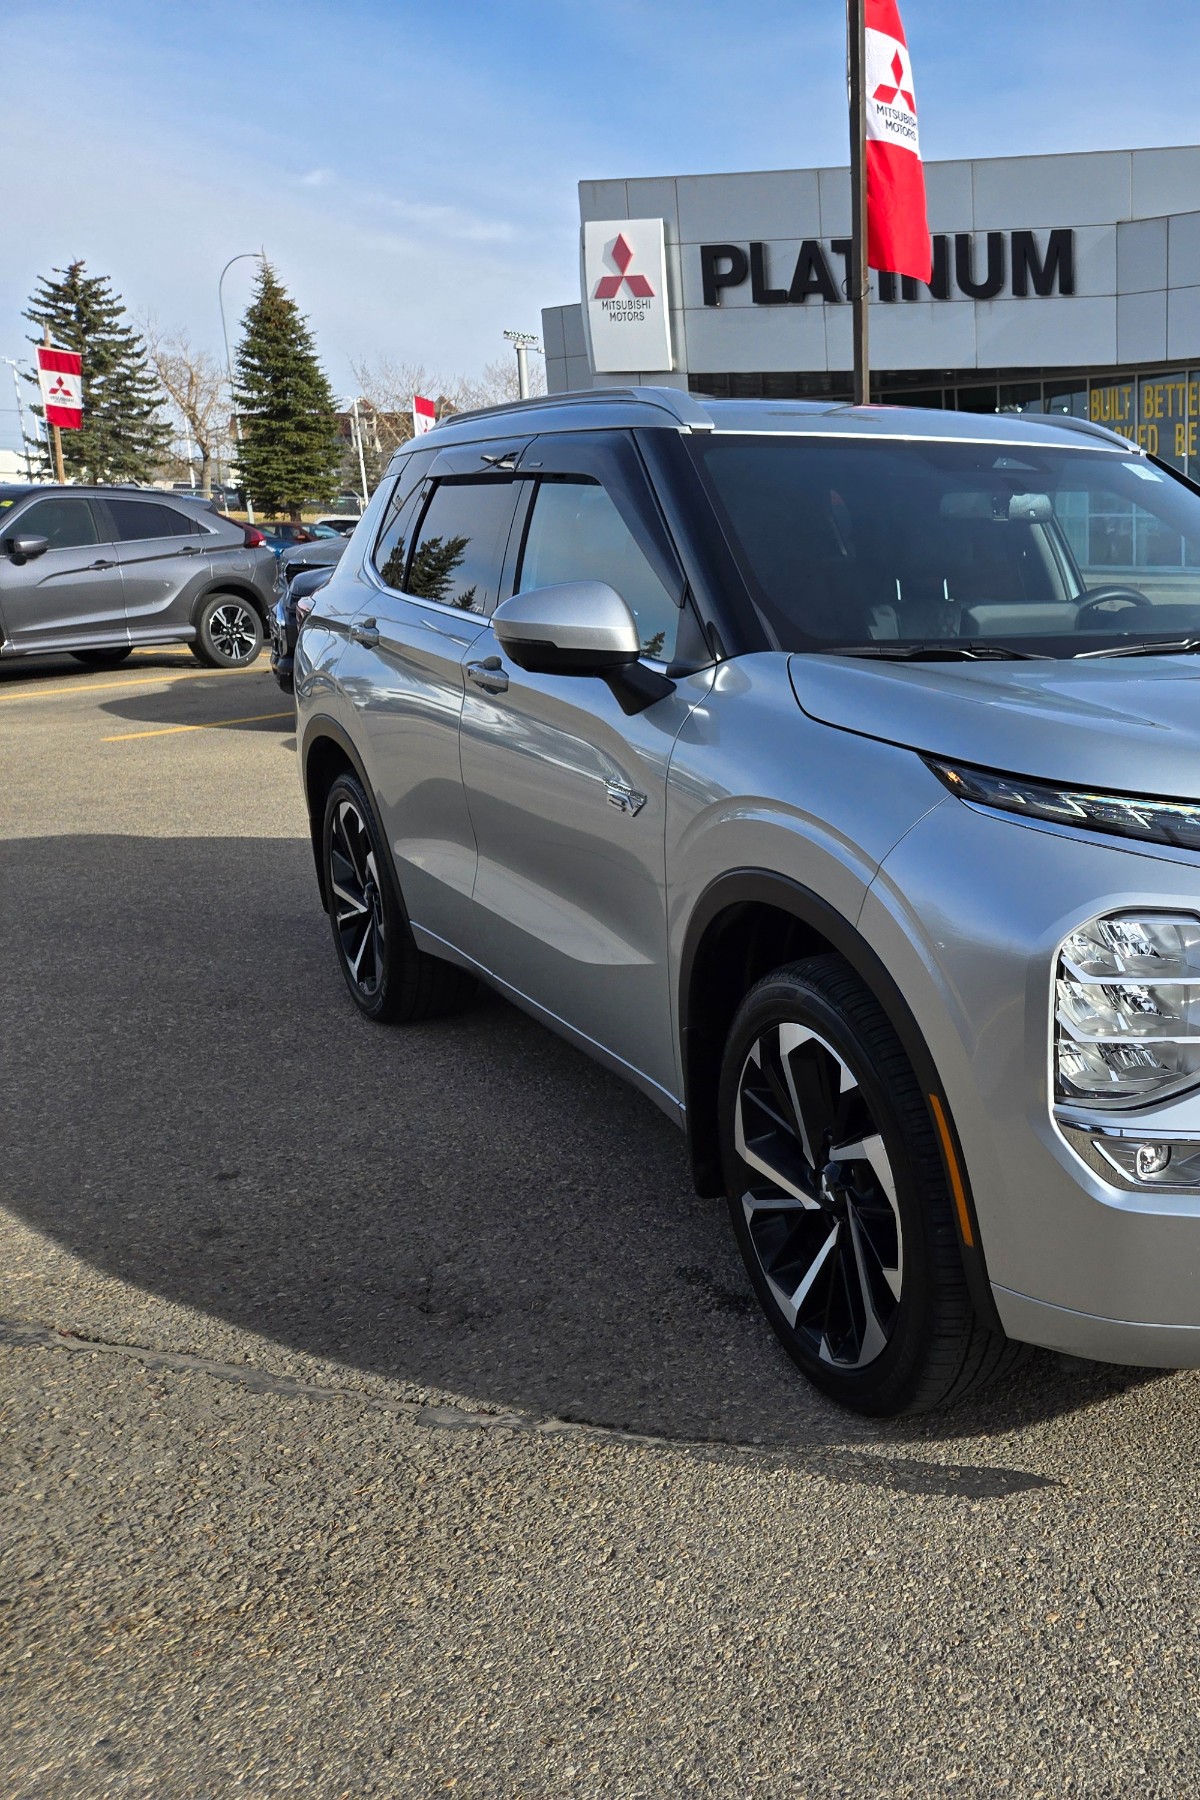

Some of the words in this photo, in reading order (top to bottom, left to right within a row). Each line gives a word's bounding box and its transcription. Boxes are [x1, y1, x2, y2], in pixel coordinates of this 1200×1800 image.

[885, 119, 917, 141] MOTORS
[602, 300, 651, 311] MITSUBISHI
[609, 311, 645, 322] MOTORS
[1091, 386, 1131, 421] BUILT
